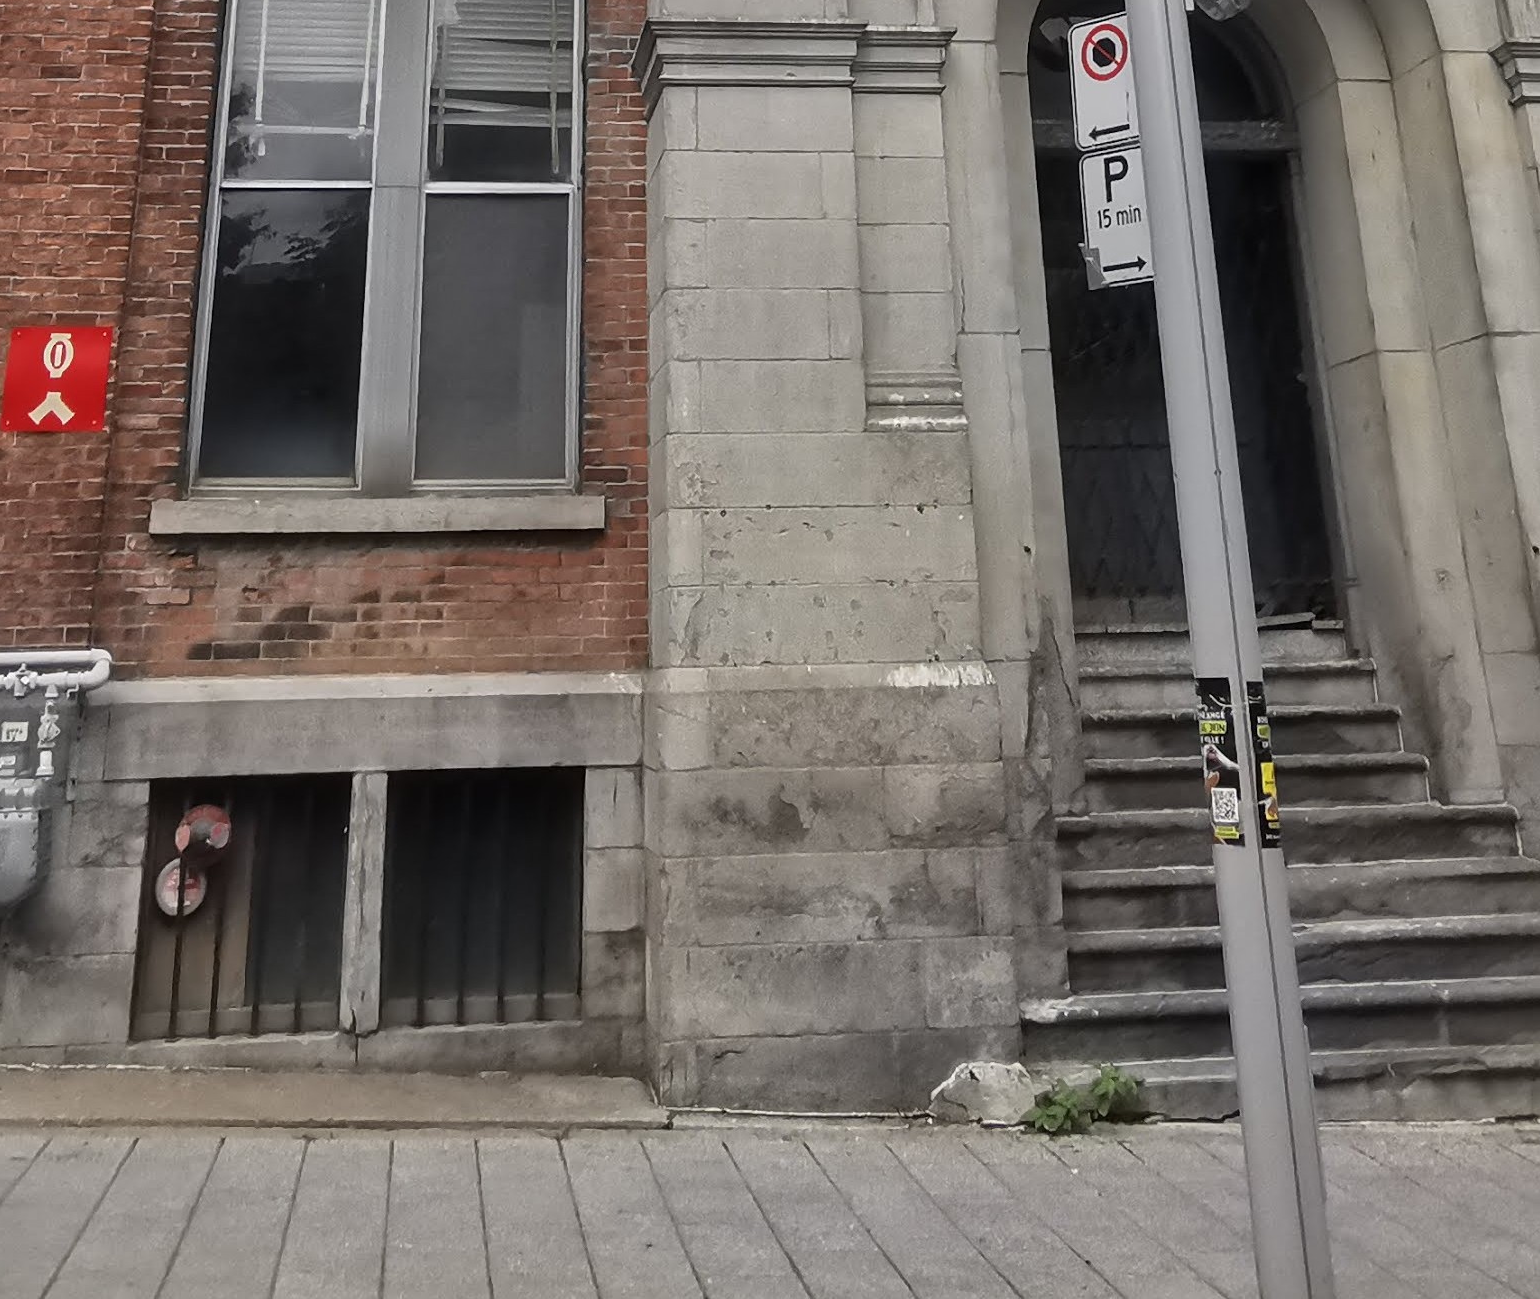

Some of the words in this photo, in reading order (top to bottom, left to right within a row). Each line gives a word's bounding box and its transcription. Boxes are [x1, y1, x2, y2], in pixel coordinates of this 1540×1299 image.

[1104, 155, 1129, 203] P
[1097, 208, 1112, 229] 15
[1116, 204, 1142, 226] min
